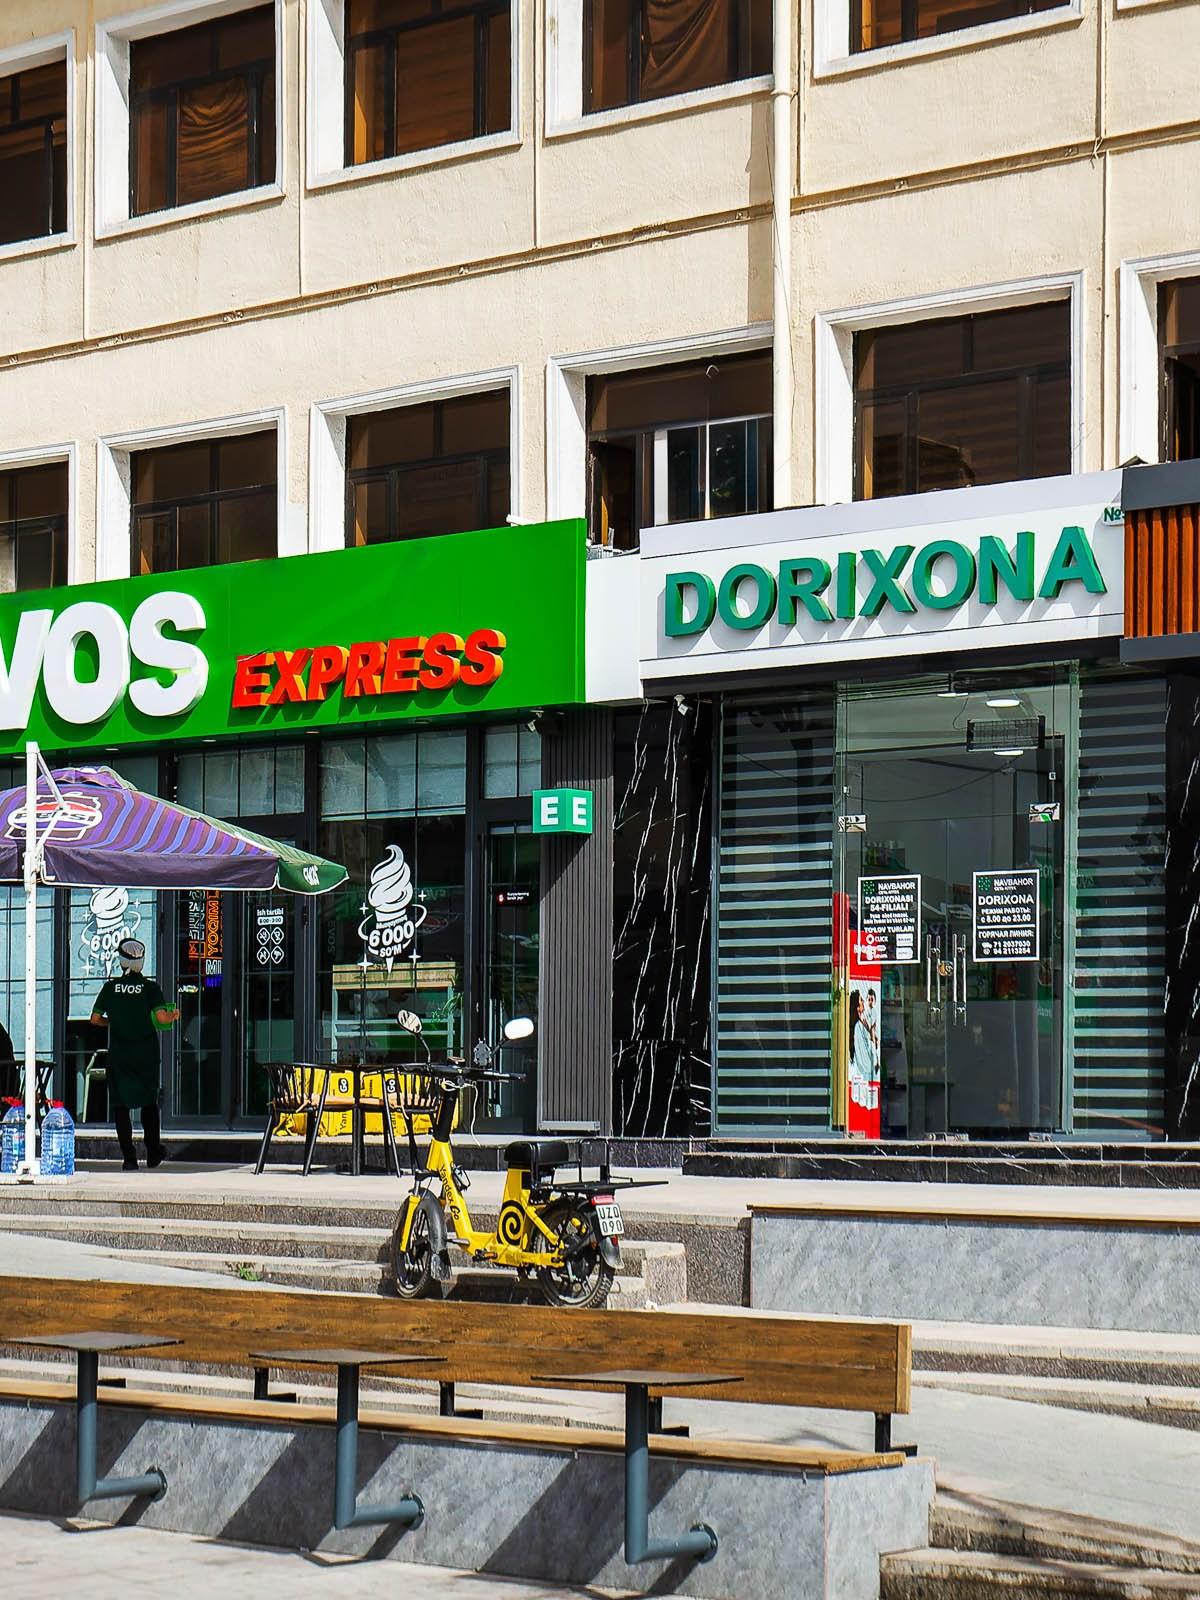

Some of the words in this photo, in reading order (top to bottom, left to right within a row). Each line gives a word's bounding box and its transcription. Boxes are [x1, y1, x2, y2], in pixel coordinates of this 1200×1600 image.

[665, 526, 1107, 638] DORIXONA
[231, 628, 506, 709] EXPRESS
[540, 797, 559, 826] E
[572, 797, 587, 826] E
[878, 882, 916, 891] NAVBAHOR
[994, 878, 1034, 887] NAVBAHOR
[865, 894, 914, 904] DORIXONASI
[978, 894, 1034, 906] DORIXONA
[115, 983, 142, 994] EVOS
[439, 1165, 455, 1203] Yandex
[451, 1206, 461, 1221] Go
[602, 1220, 623, 1233] 090
